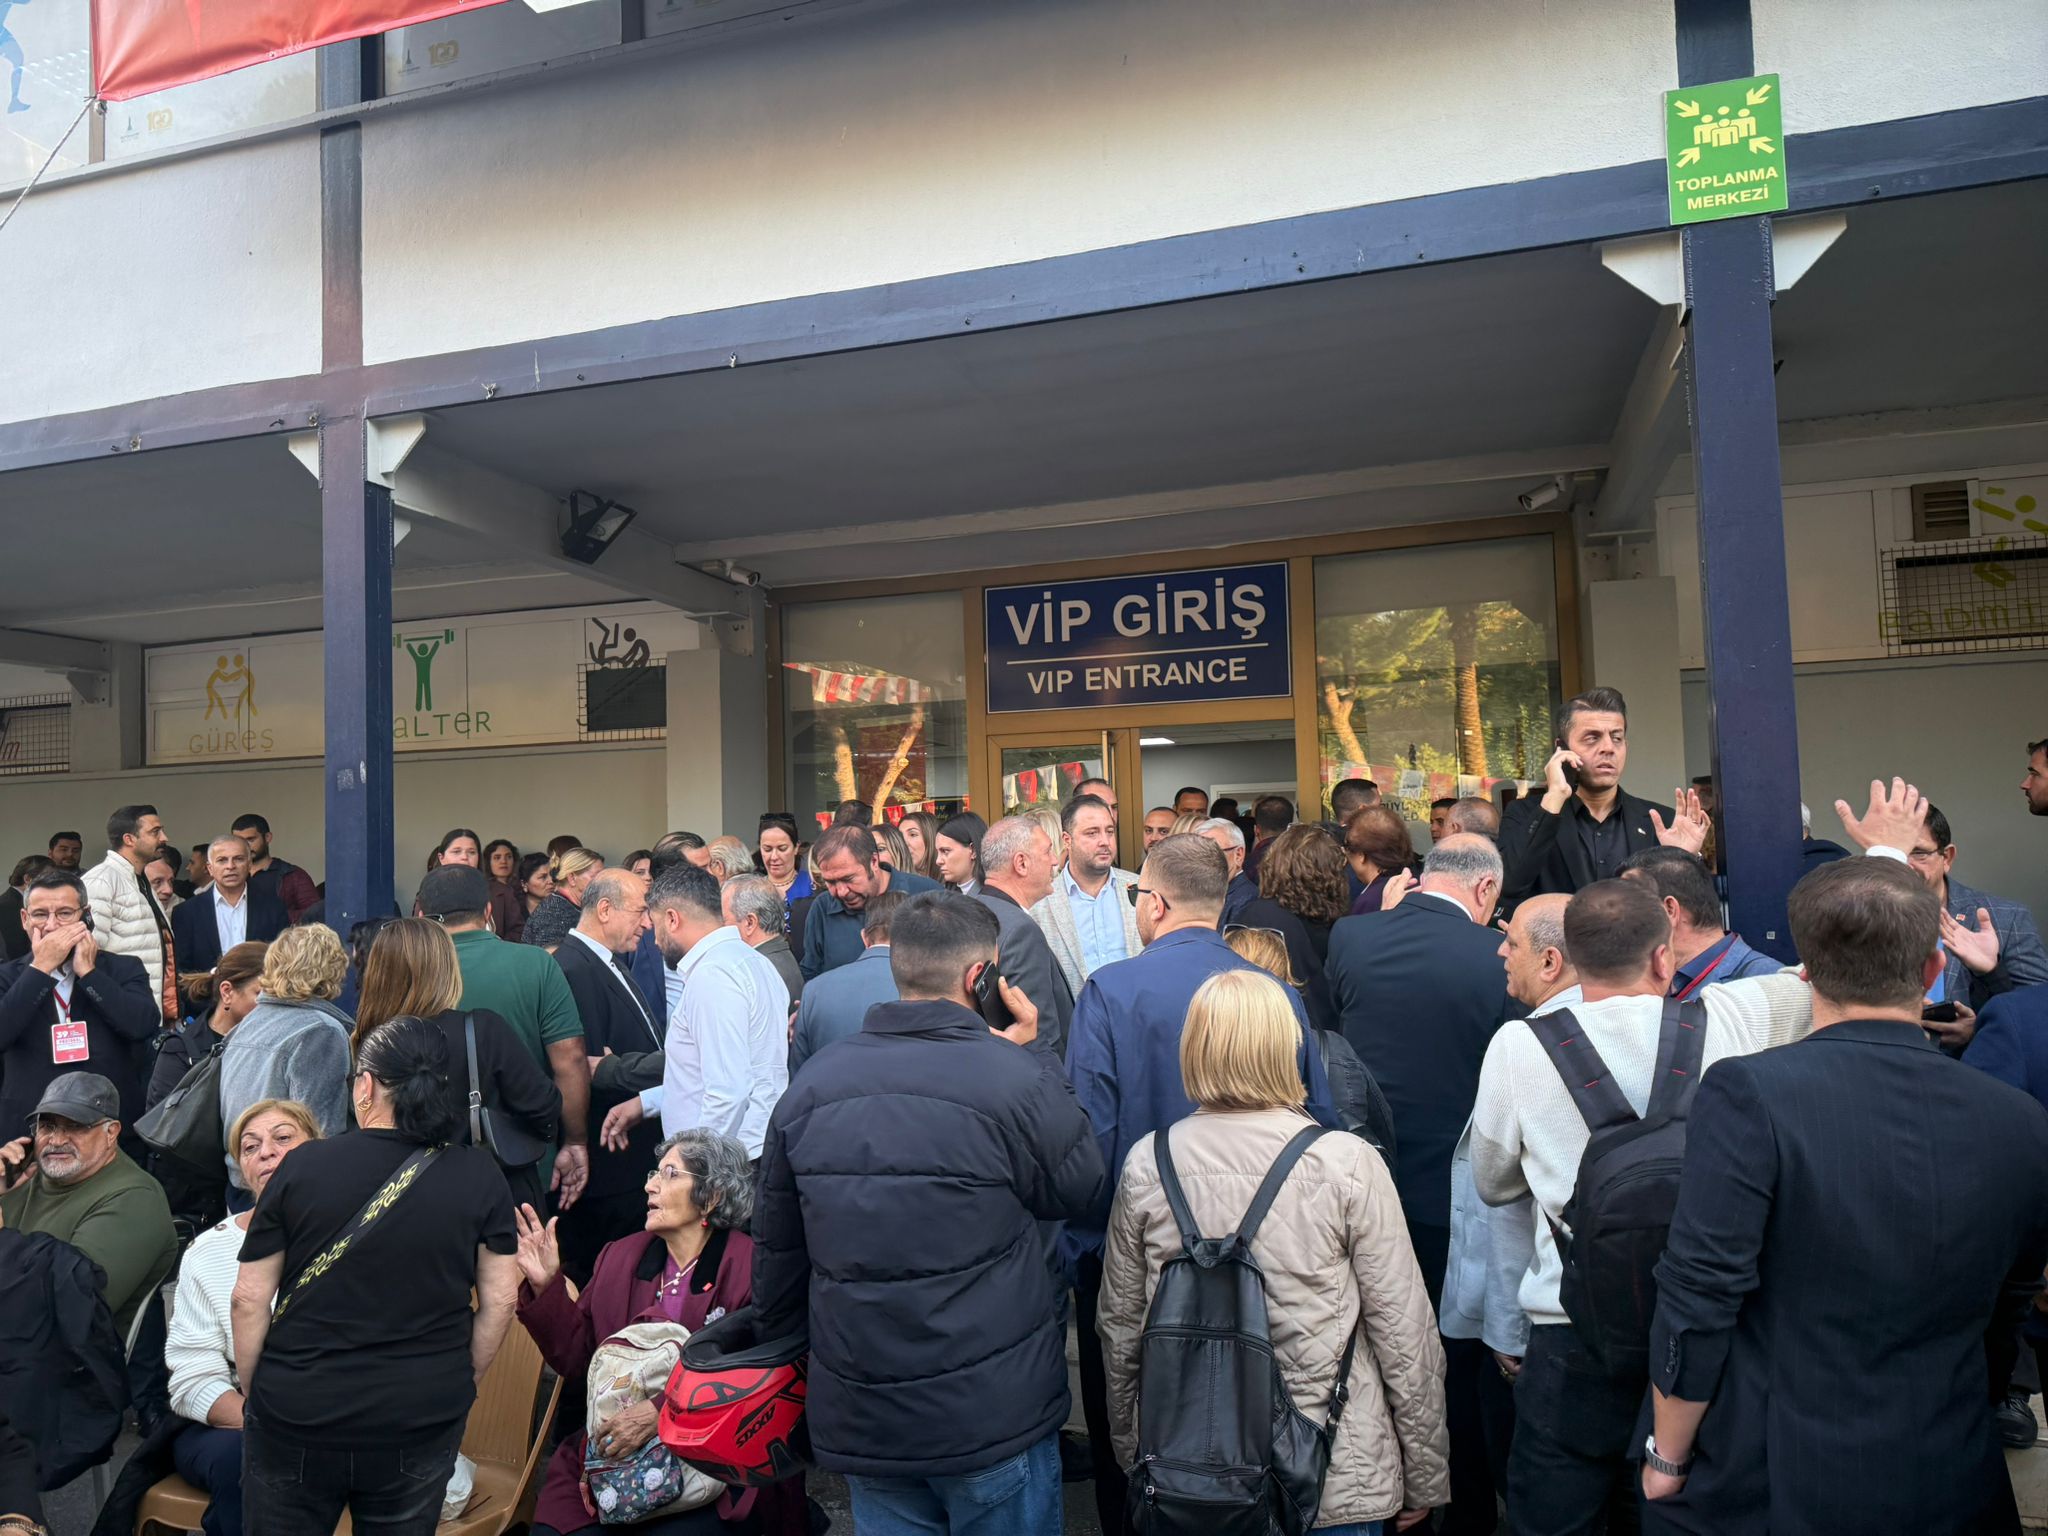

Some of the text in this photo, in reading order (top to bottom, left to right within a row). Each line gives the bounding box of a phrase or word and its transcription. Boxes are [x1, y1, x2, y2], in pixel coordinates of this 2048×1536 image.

[1676, 166, 1778, 192] TOPLANMA
[1687, 184, 1769, 210] MERKEZİ
[1005, 577, 1266, 645] VİP GİRİŞ
[1027, 657, 1248, 694] VIP ENTRANCE
